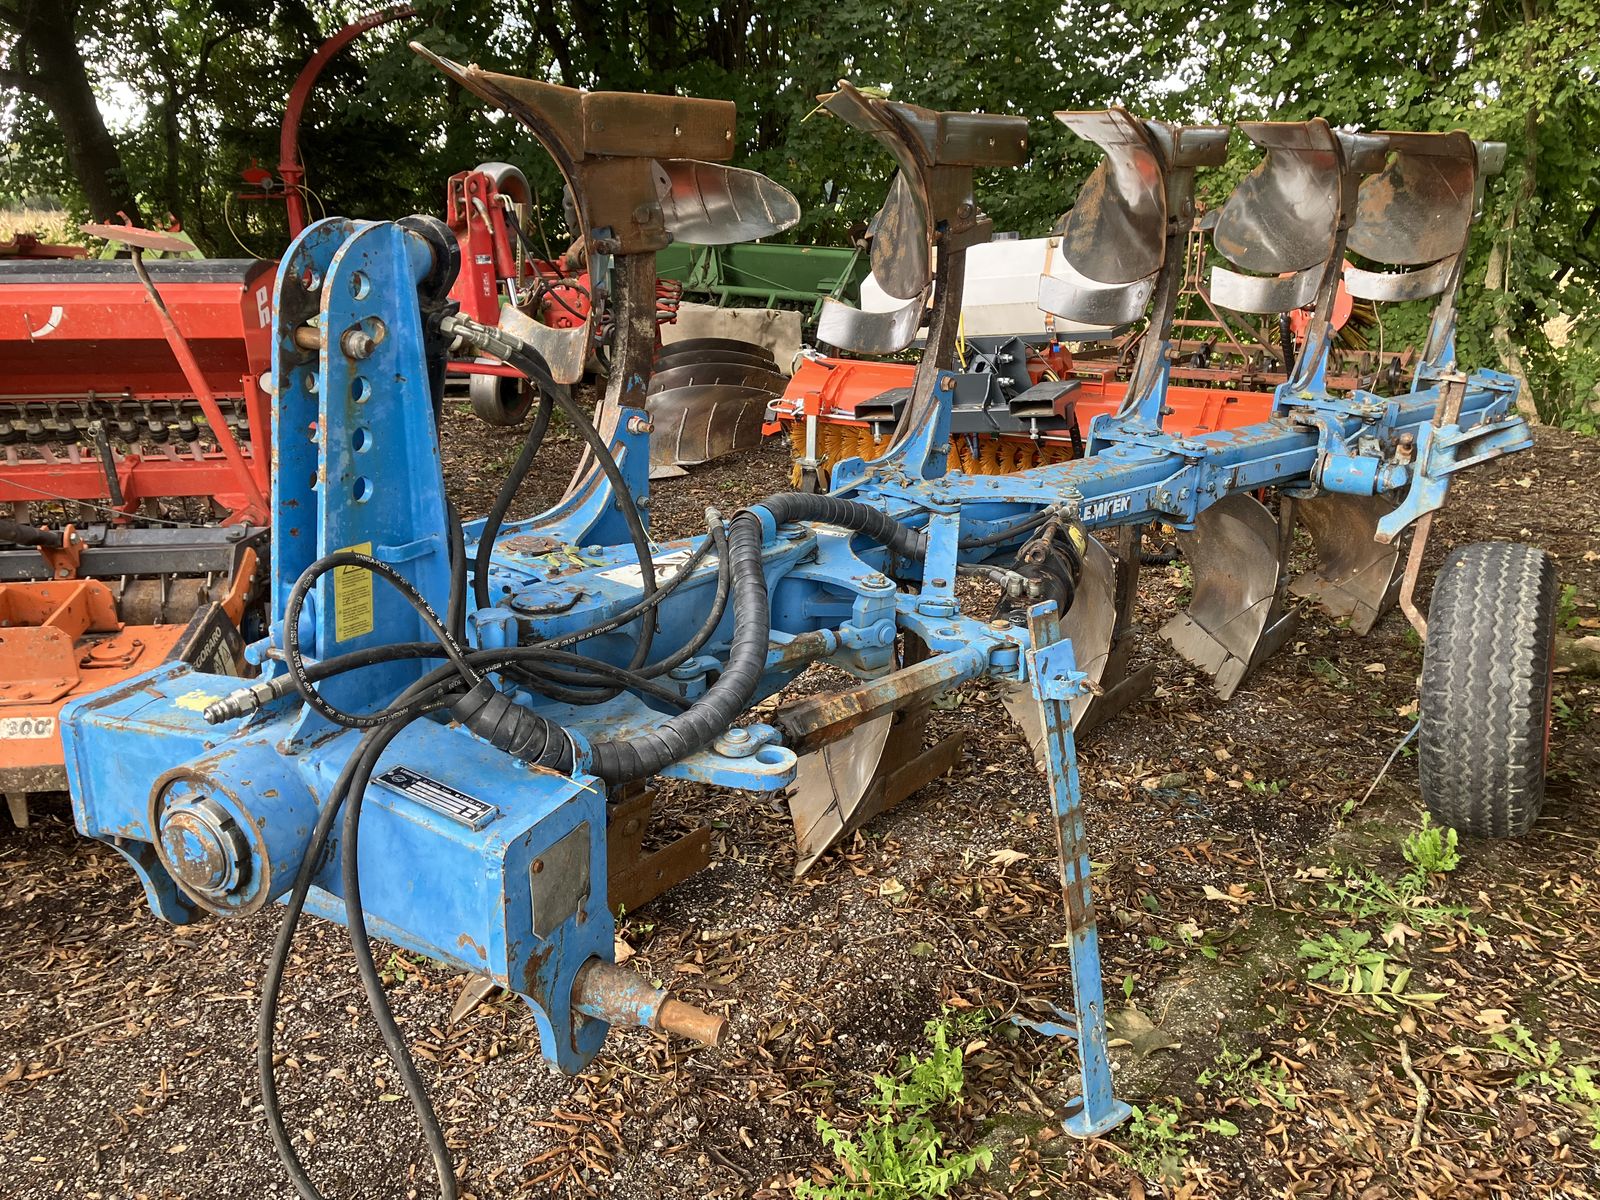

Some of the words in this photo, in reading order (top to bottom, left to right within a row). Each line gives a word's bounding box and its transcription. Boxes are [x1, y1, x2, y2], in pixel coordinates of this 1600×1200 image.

[292, 650, 302, 668] BAR
[297, 668, 307, 681] 350
[303, 681, 313, 693] WP
